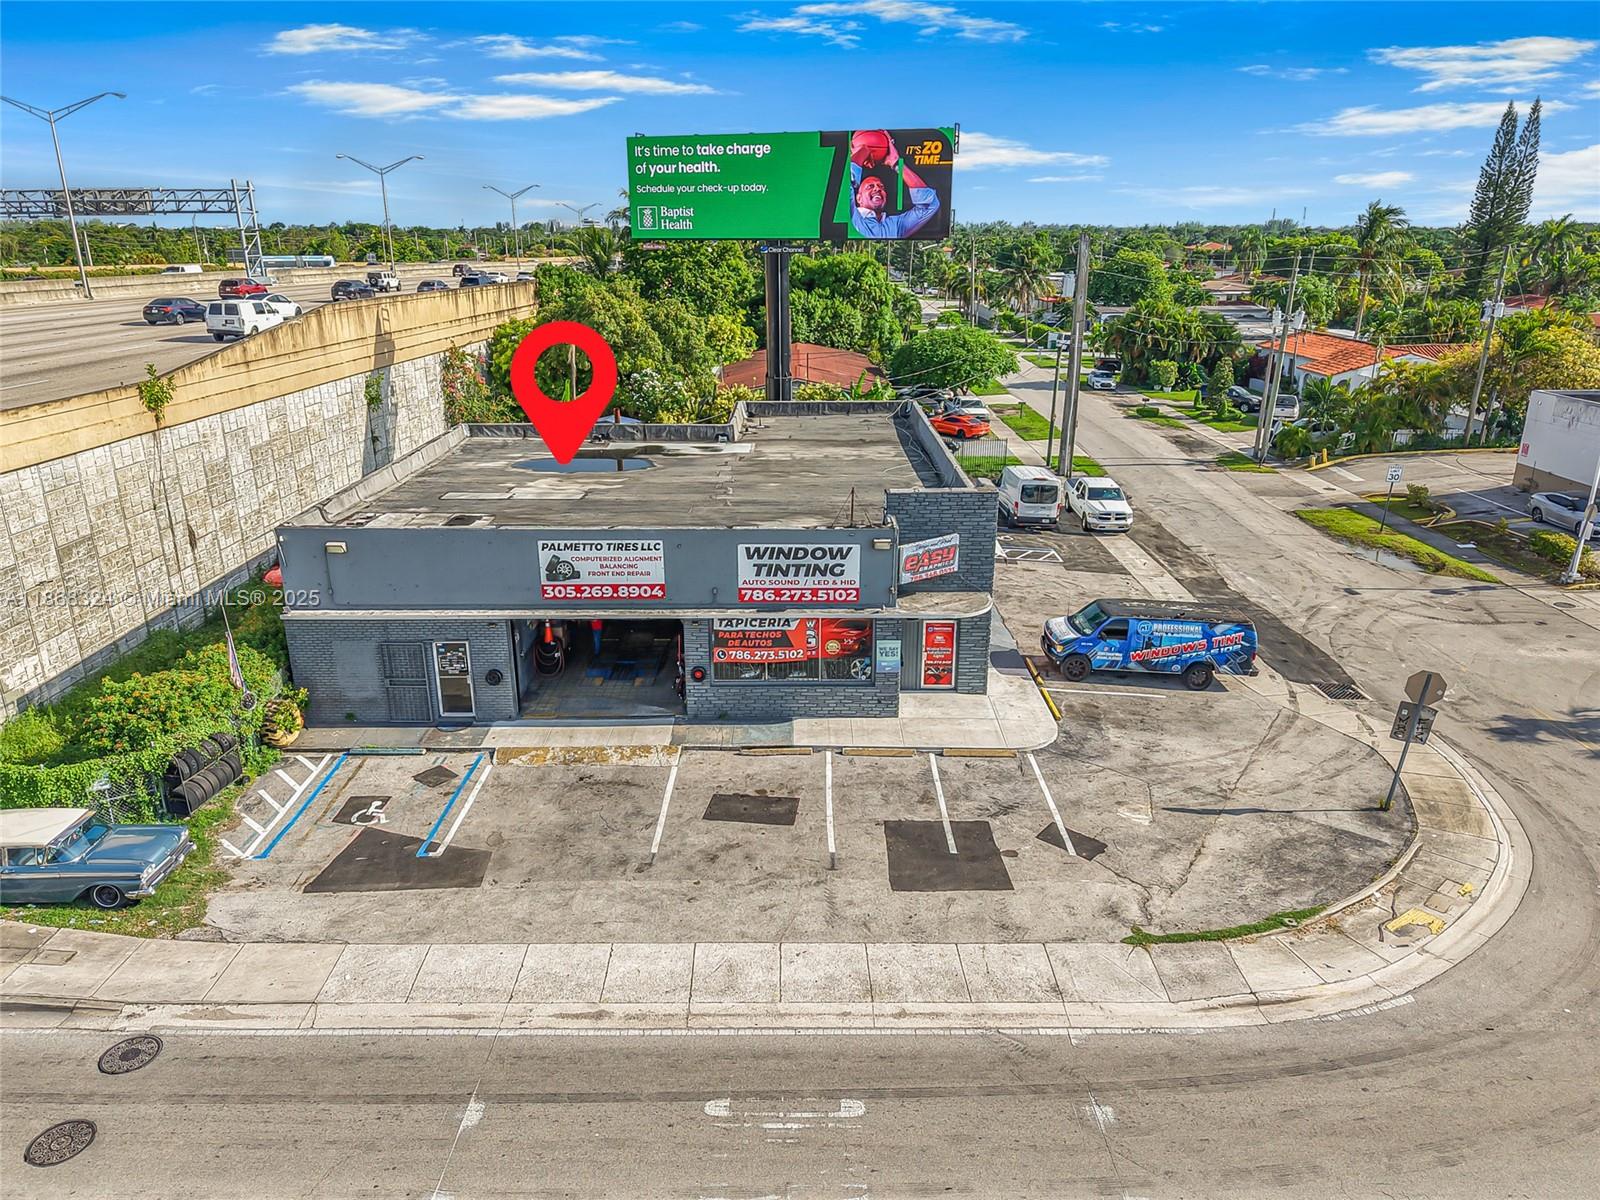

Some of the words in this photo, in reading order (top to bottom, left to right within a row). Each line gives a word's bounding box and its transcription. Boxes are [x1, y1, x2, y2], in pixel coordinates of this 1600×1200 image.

[634, 145, 650, 157] It's
[653, 144, 680, 156] time
[682, 144, 694, 155] to
[697, 143, 724, 155] take
[726, 143, 771, 158] charge
[922, 141, 943, 154] ZO
[636, 162, 646, 174] of
[648, 163, 677, 177] your
[678, 161, 720, 173] health.
[636, 184, 674, 193] Schedule
[677, 185, 695, 194] your
[697, 184, 740, 194] check-up
[741, 184, 769, 194] today.
[660, 206, 694, 218] Baptist
[661, 219, 692, 230] Health
[541, 542, 603, 552] PALMETTO
[606, 542, 638, 551] TIRES
[641, 542, 661, 551] LLC
[745, 546, 853, 560] WINDOW
[753, 563, 845, 577] TINTING
[543, 586, 664, 598] 305.269.8904
[741, 590, 857, 601] 786.273.5102
[718, 618, 791, 628] TAPICERIA
[1154, 623, 1202, 633] PROFESSIONAL
[1130, 639, 1207, 662] WINDOWS
[1212, 632, 1245, 647] TINT
[729, 650, 804, 660] 786.273.5102
